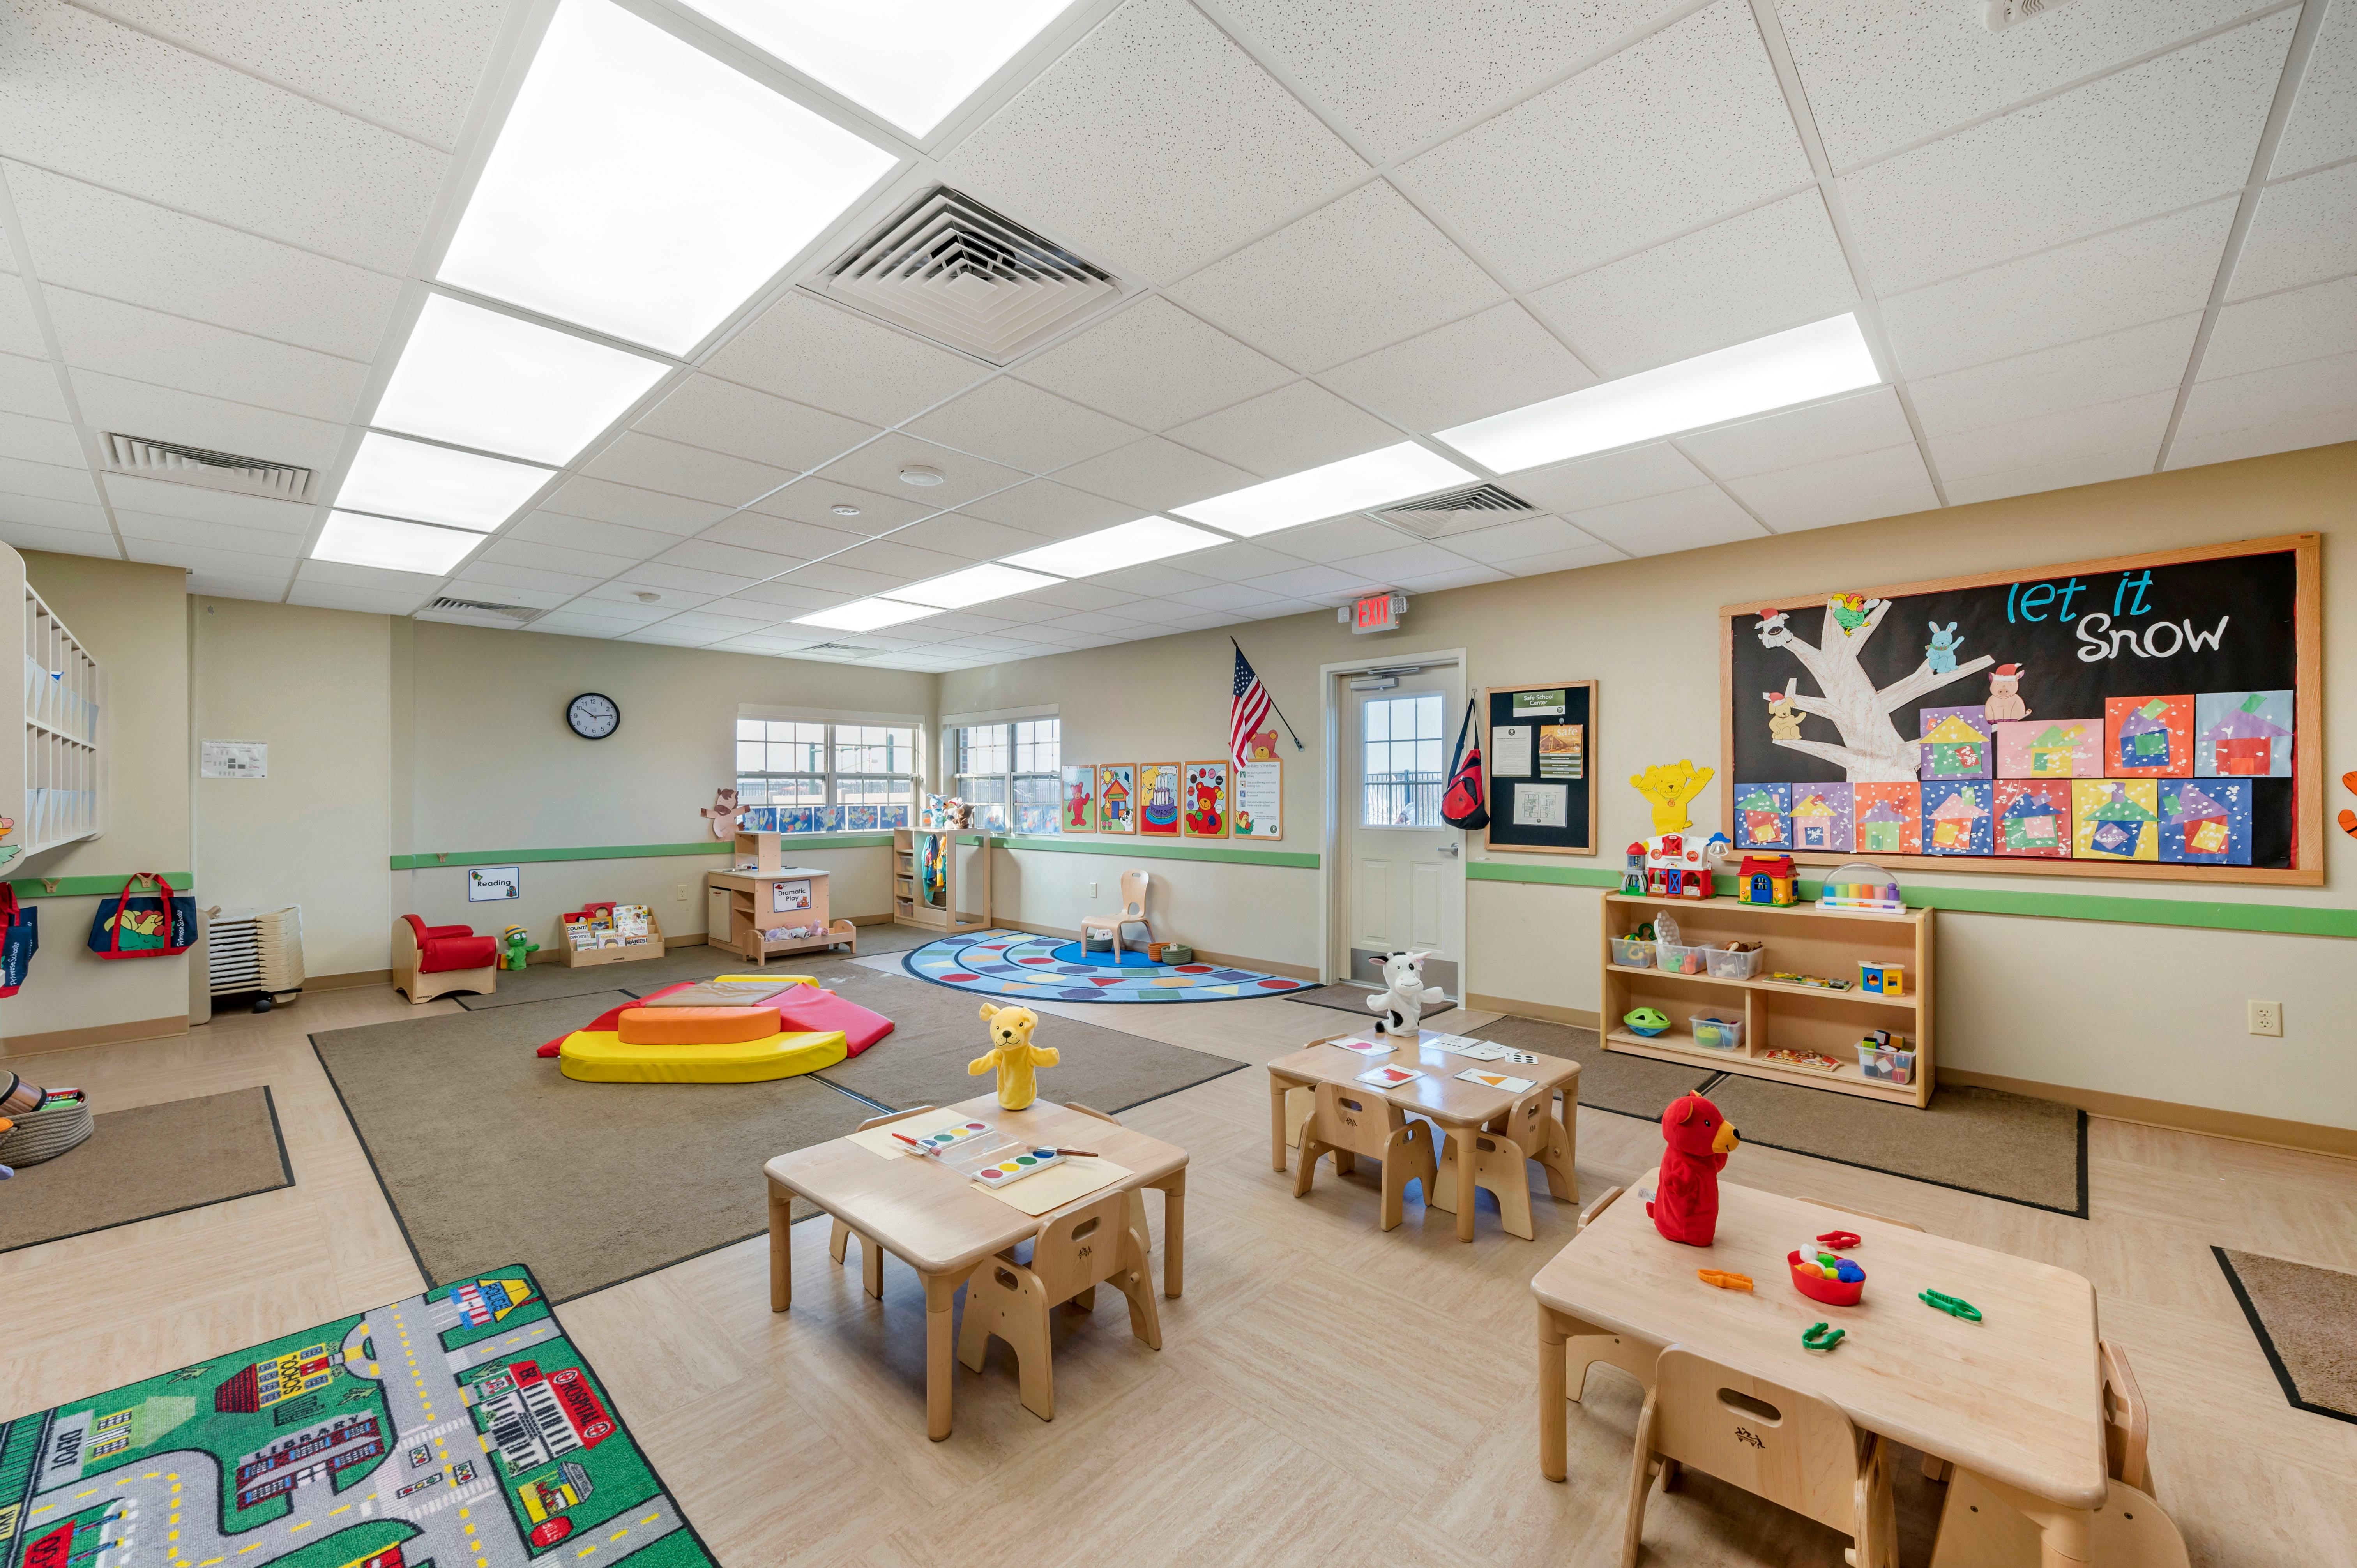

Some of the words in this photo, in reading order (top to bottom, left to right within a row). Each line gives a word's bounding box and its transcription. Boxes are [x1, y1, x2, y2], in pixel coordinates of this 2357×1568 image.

[1358, 595, 1389, 627] EXIT
[2007, 577, 2087, 623] let
[2113, 570, 2153, 616] it
[1557, 727, 1578, 736] safe
[486, 1284, 509, 1312] POLICE
[279, 1355, 302, 1395] SCHOOL
[519, 1367, 537, 1381] ER
[560, 1379, 601, 1427] HOSPITAL
[51, 1428, 83, 1471] DEPOT
[254, 1415, 359, 1459] LIBRARY
